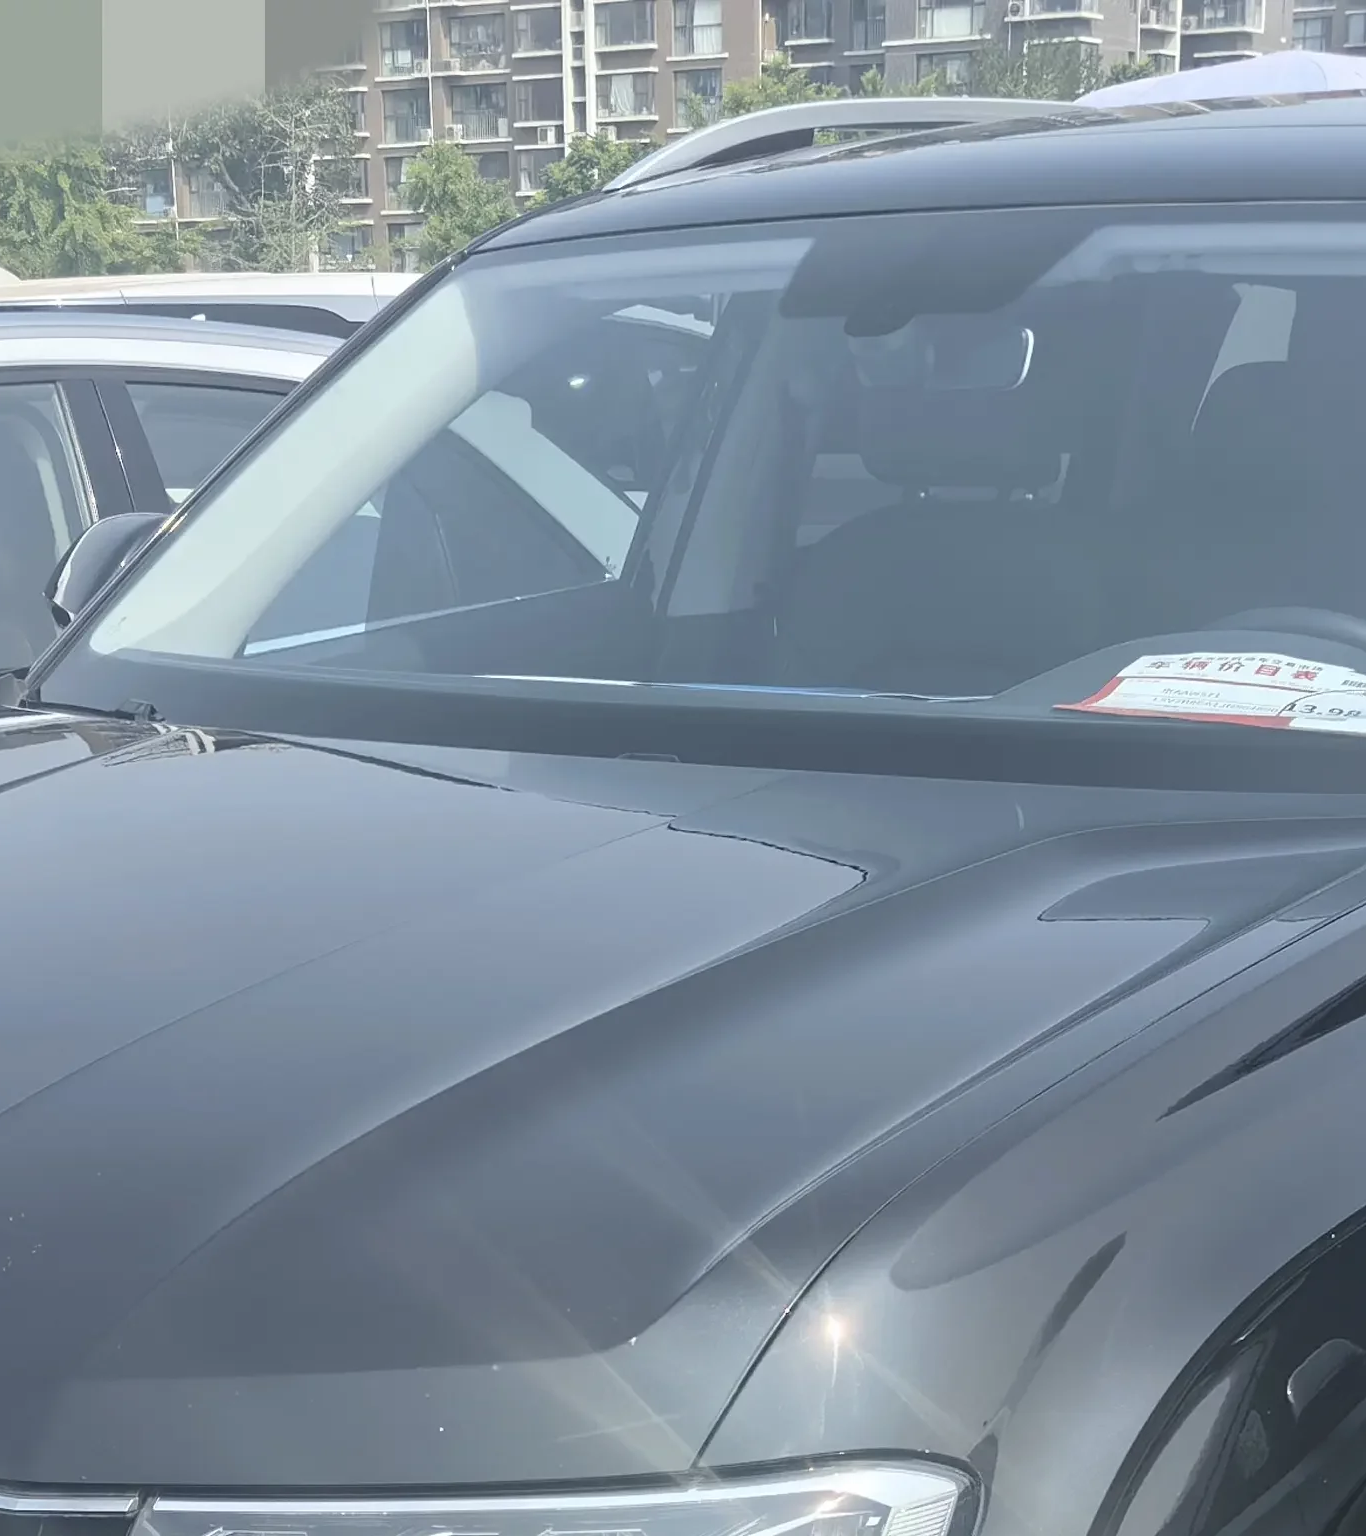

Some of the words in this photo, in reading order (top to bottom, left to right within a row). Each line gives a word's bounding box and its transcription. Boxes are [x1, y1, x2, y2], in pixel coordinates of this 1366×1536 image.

[1145, 660, 1318, 681] 车辆价目表
[1285, 702, 1362, 718] 13.98
